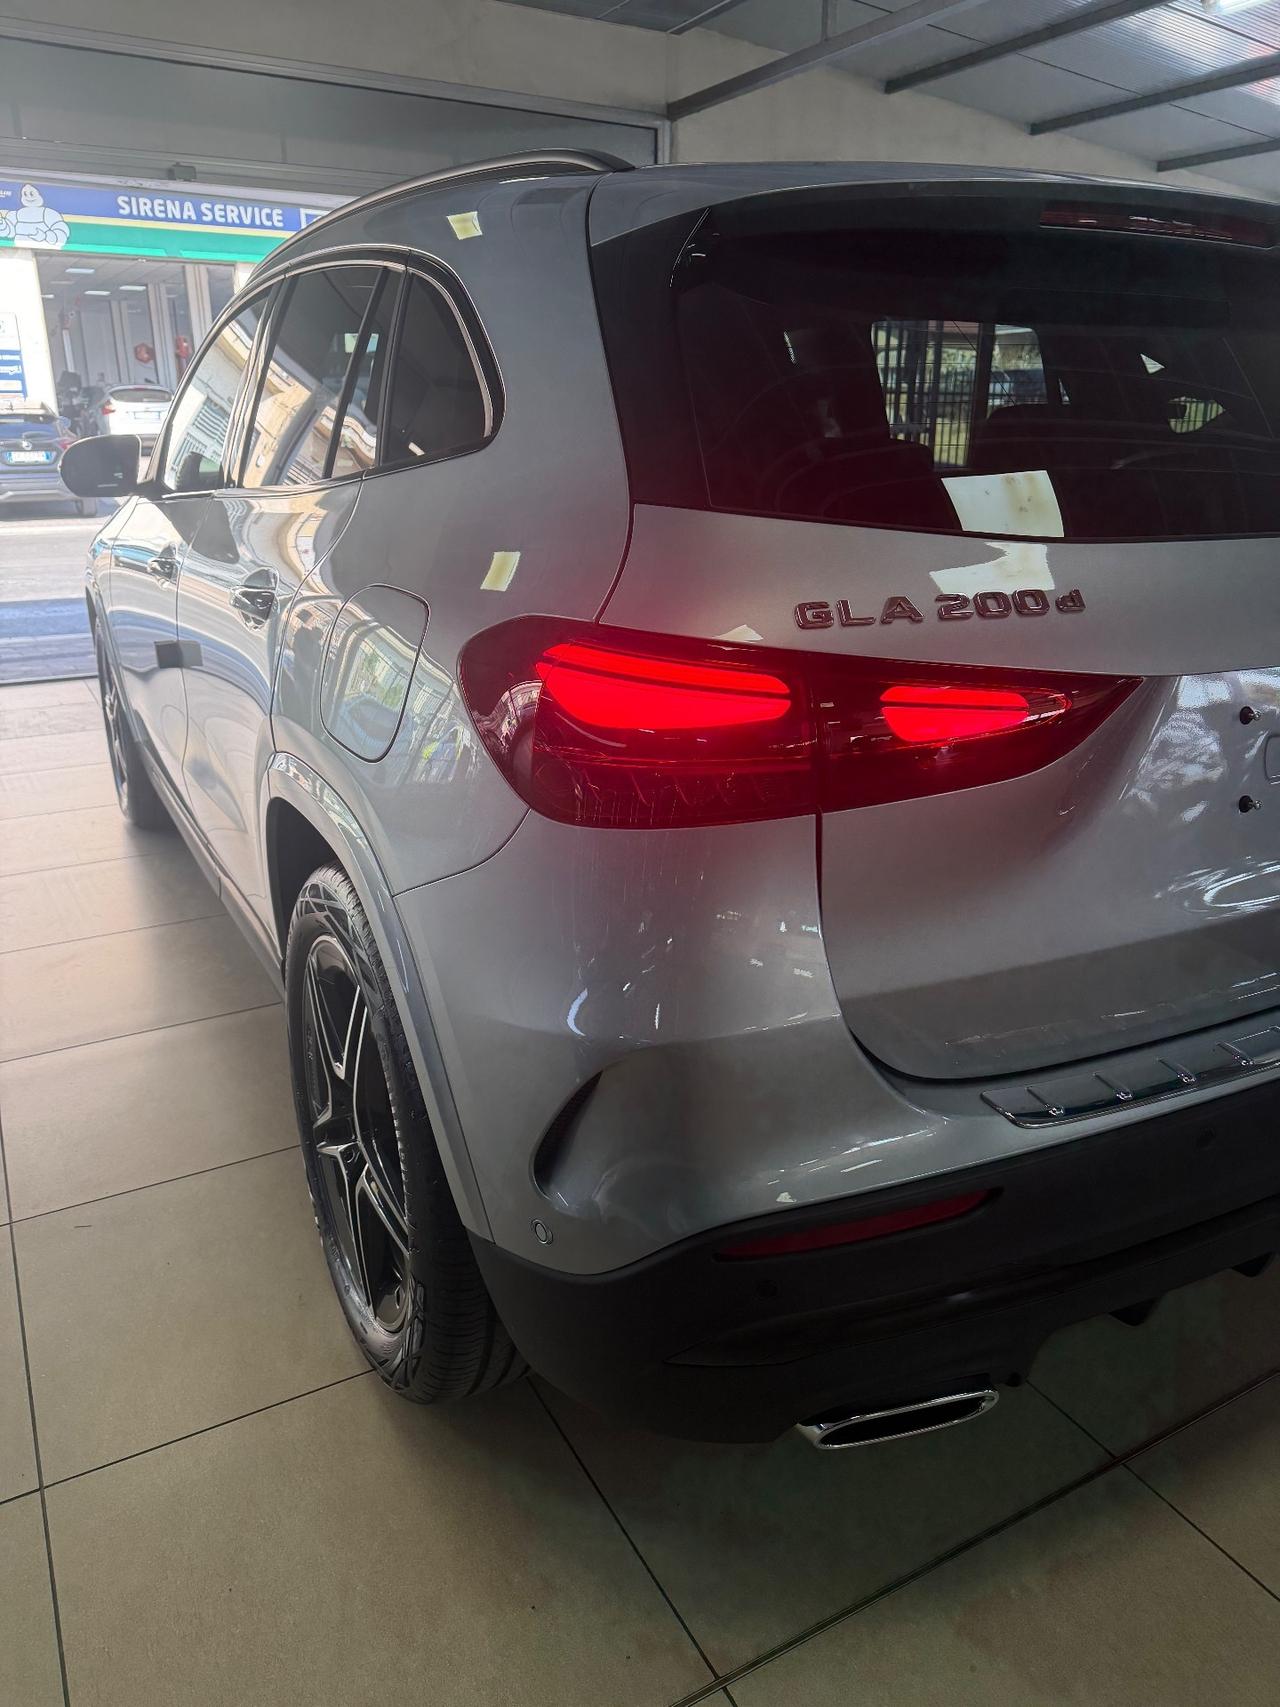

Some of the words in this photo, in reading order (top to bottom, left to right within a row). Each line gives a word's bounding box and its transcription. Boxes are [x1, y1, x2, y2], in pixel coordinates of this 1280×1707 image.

[117, 196, 197, 221] SIRENA
[201, 203, 285, 227] SERVICE
[795, 596, 925, 629] GLA
